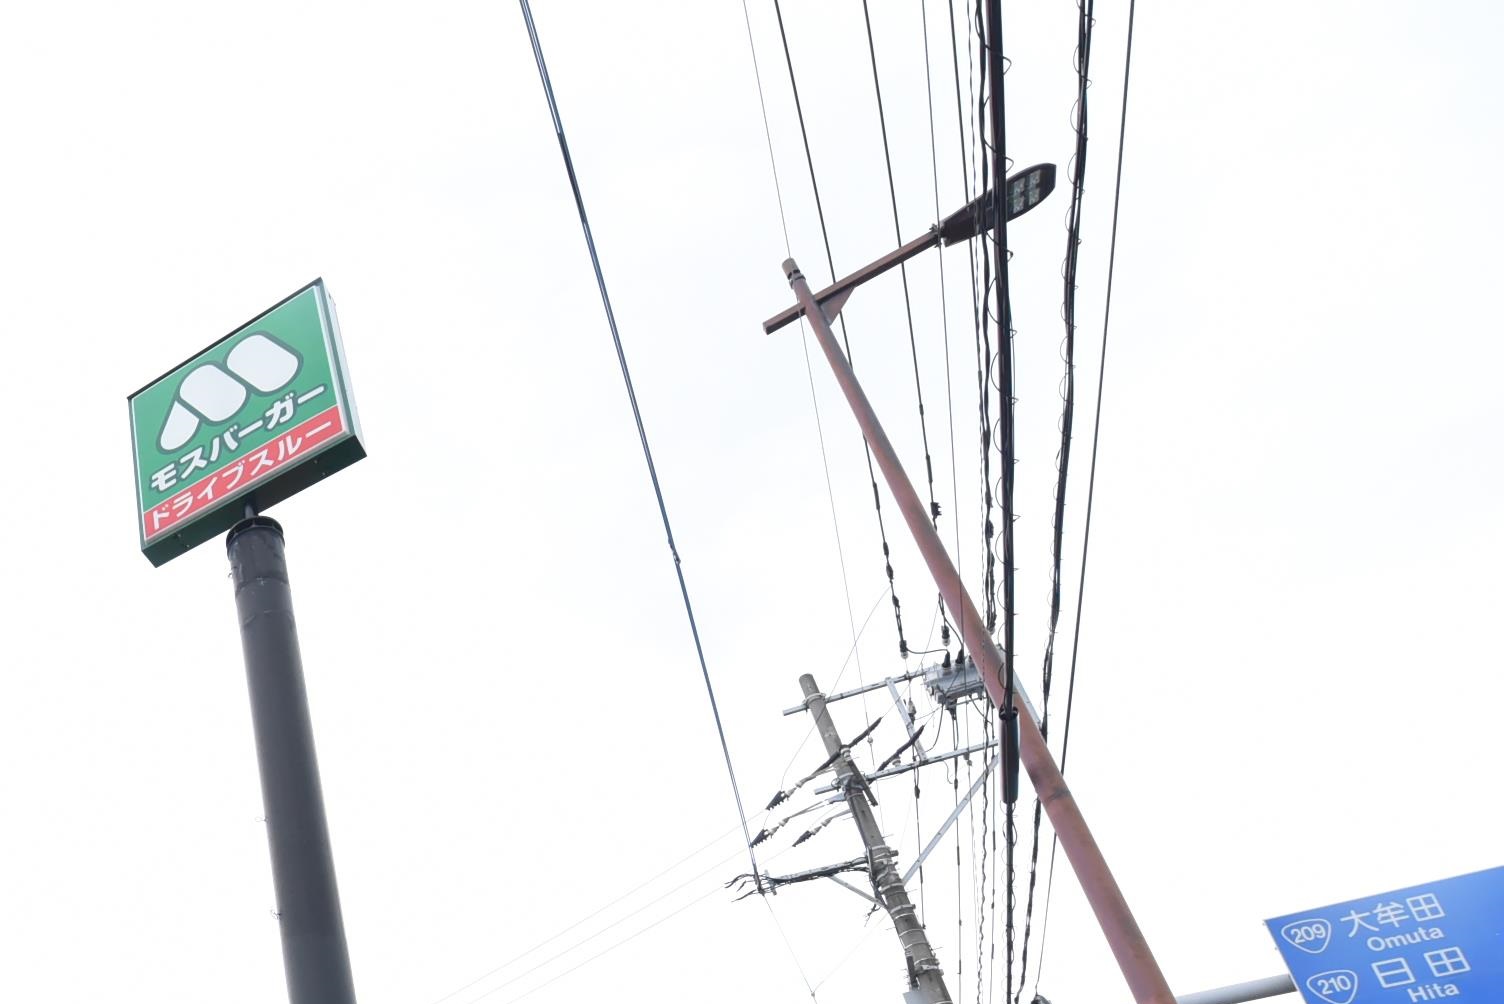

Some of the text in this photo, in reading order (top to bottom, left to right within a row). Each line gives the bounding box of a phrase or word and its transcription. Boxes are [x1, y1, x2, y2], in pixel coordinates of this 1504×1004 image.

[150, 385, 326, 492] モスバーガー
[152, 420, 332, 529] ドライブスルー
[1340, 893, 1446, 937] 大牟田
[1290, 922, 1327, 944] 209
[1366, 925, 1445, 952] Omuta
[1371, 946, 1471, 988] 日田
[1317, 974, 1351, 995] 210
[1407, 982, 1460, 1003] Hita
